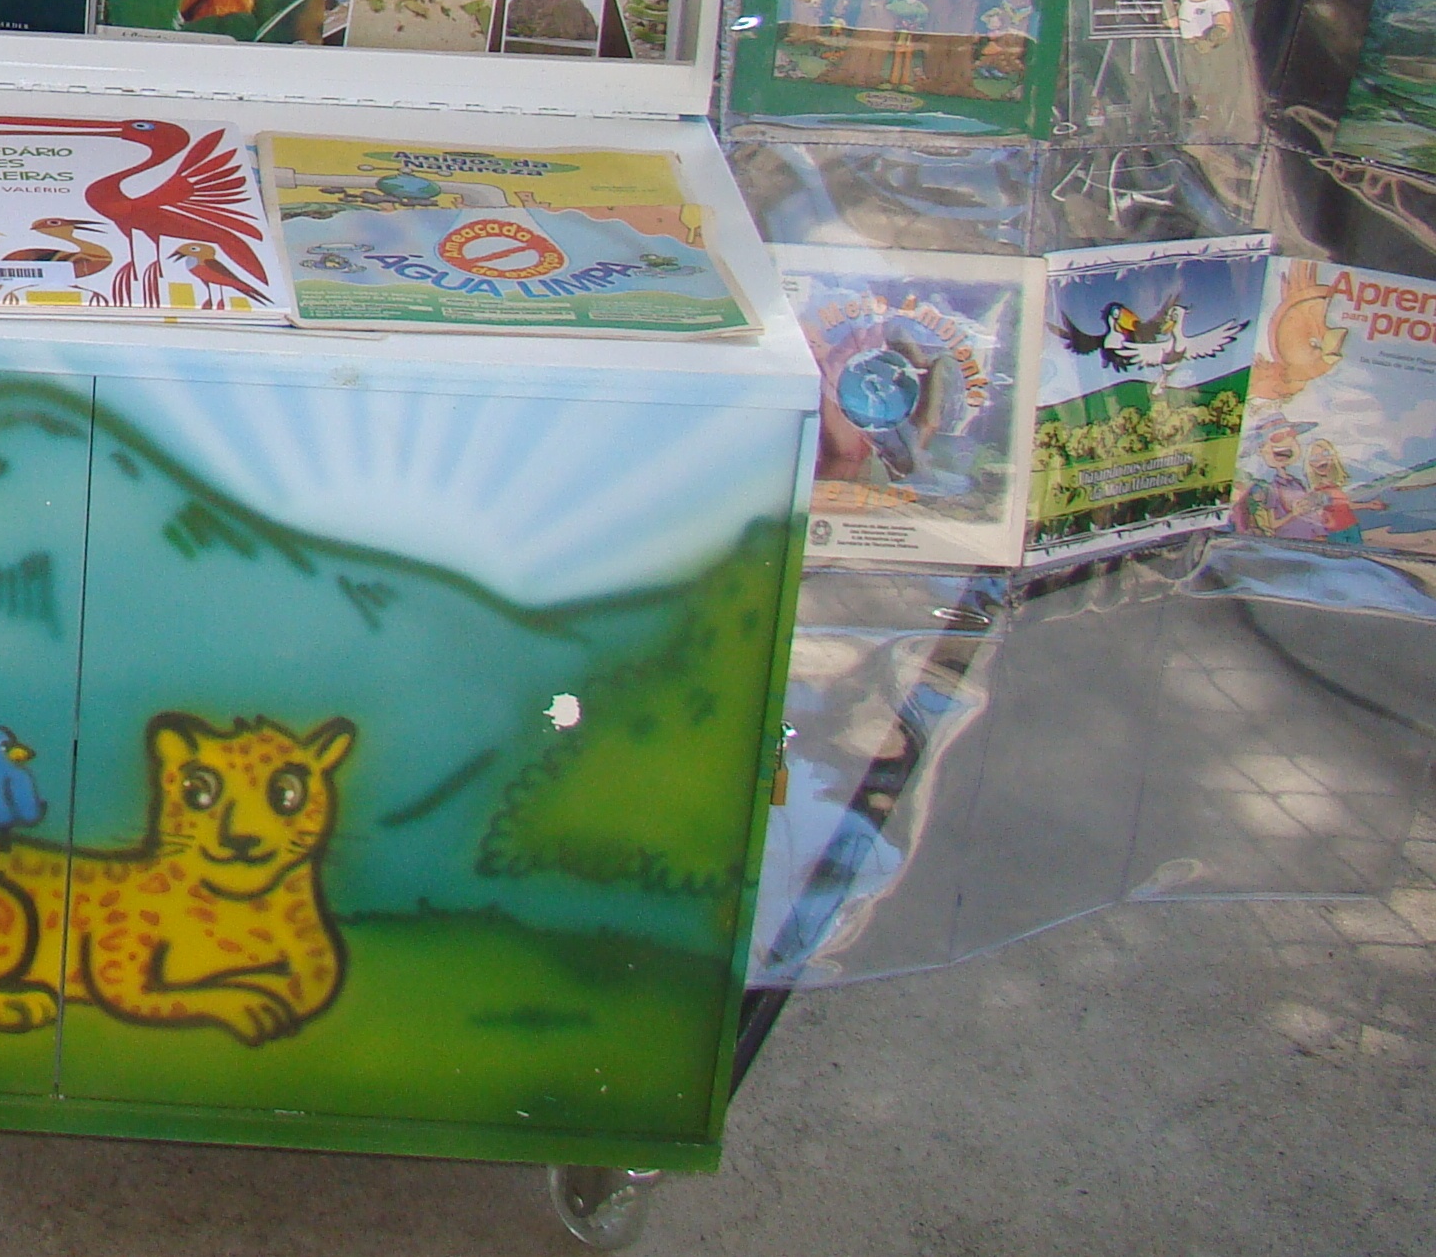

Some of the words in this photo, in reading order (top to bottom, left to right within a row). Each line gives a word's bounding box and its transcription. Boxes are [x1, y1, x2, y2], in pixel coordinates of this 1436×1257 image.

[393, 151, 503, 168] Amigos
[513, 158, 549, 170] da
[402, 159, 544, 177] Natureza
[2, 186, 70, 194] VALÉRIO
[443, 222, 532, 259] Ameaçada
[471, 266, 499, 278] de
[504, 252, 561, 279] extinção
[364, 254, 506, 298] ÁGUA
[516, 260, 643, 298] LIMPA
[1341, 312, 1368, 322] para
